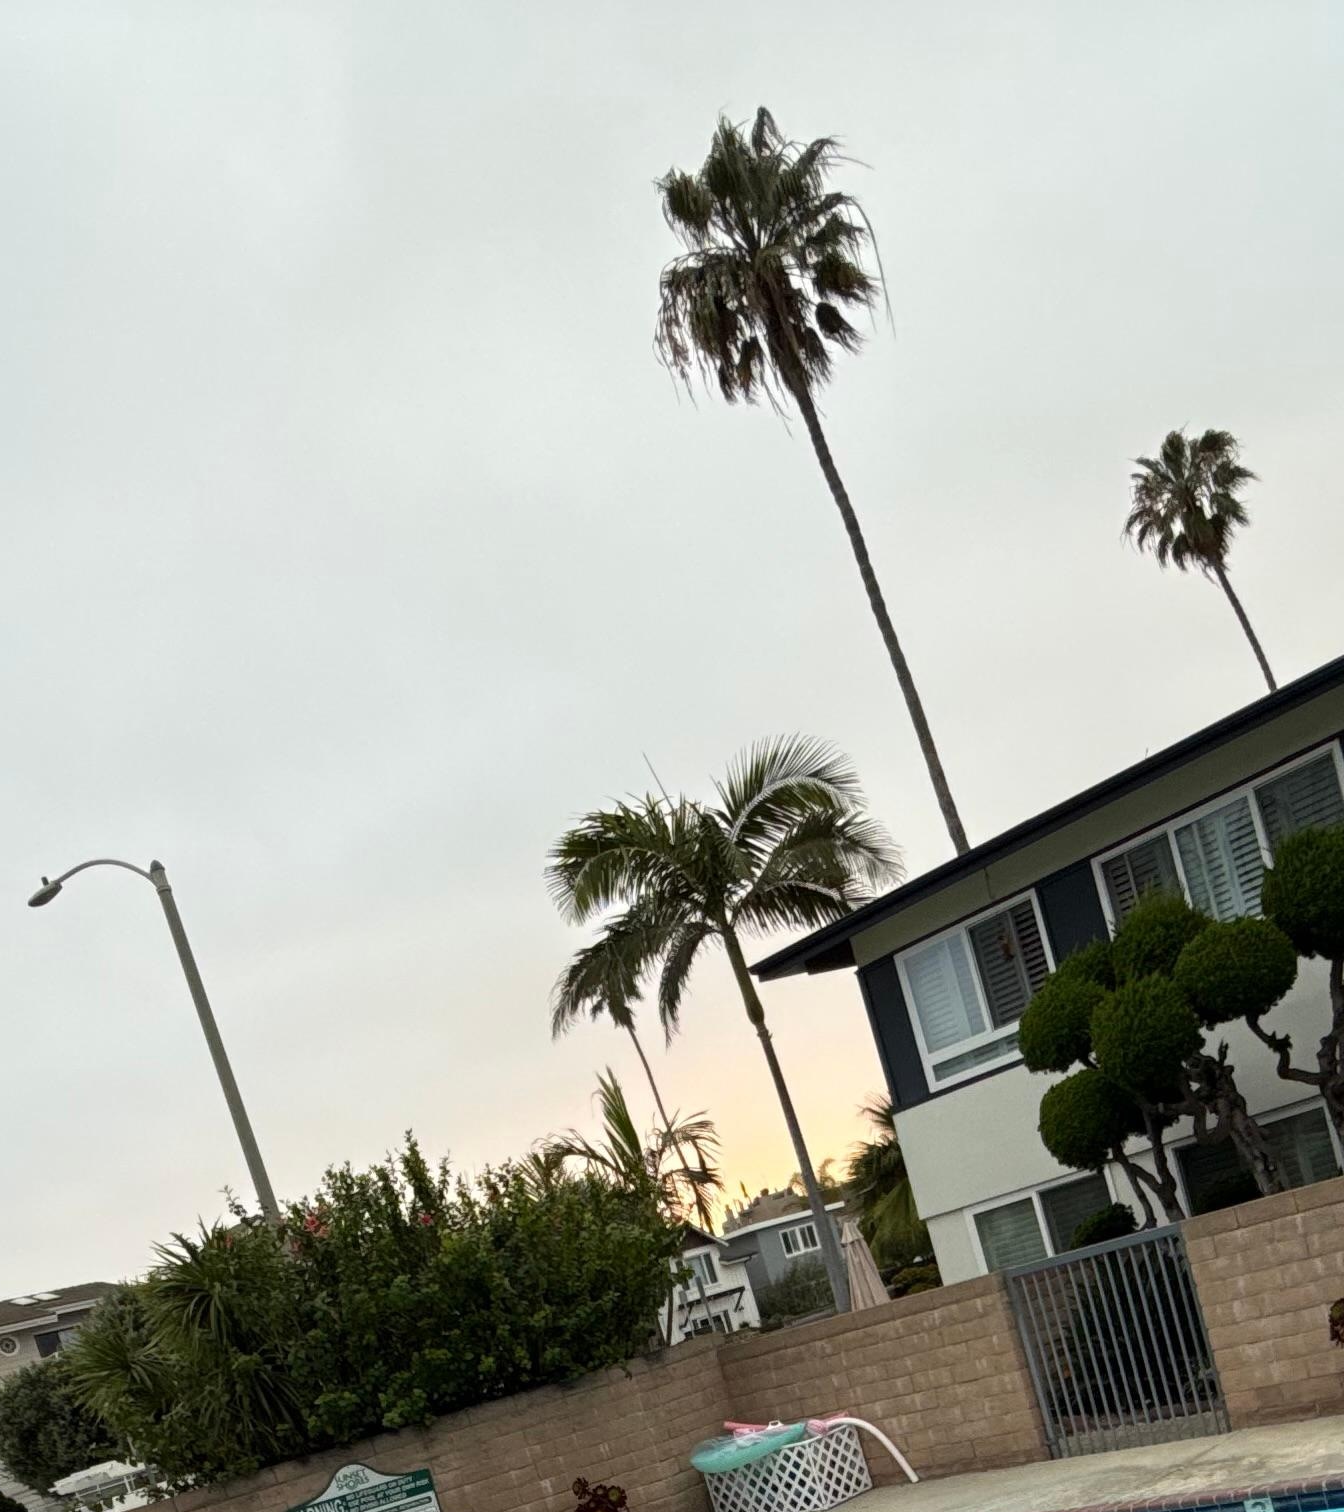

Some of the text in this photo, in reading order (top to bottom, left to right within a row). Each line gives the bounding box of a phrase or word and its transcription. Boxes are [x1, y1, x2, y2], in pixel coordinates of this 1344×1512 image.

[336, 1469, 365, 1484] SUNSET
[336, 1477, 369, 1490] SHORES
[356, 1483, 387, 1498] LIFEGUARD
[398, 1476, 413, 1486] DUTY
[360, 1495, 376, 1504] POOL
[377, 1491, 385, 1499] AT
[385, 1486, 401, 1496] YOUR
[380, 1492, 407, 1504] ALLOWED
